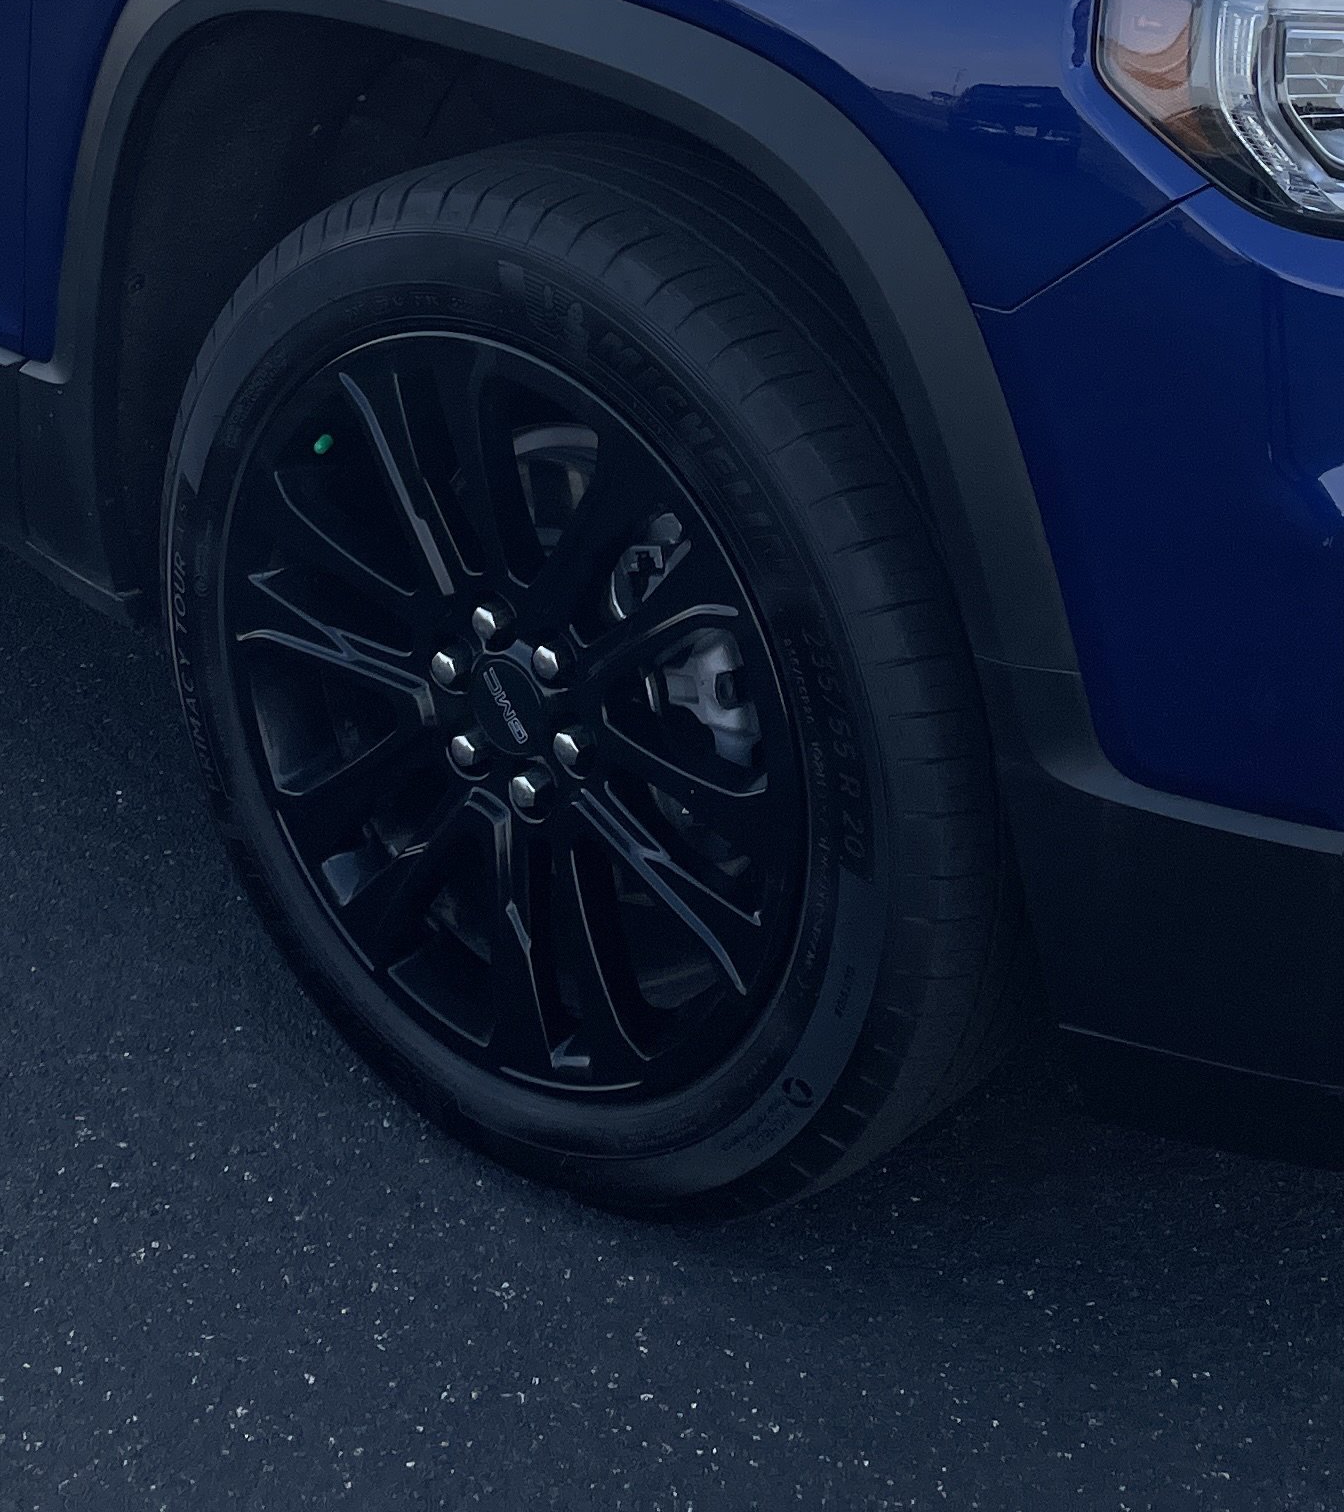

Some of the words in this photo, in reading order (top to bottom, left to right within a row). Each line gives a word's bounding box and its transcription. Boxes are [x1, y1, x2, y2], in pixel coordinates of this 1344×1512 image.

[172, 552, 188, 634] TOUR
[176, 648, 221, 792] PRIMACY
[482, 666, 529, 745] GMC
